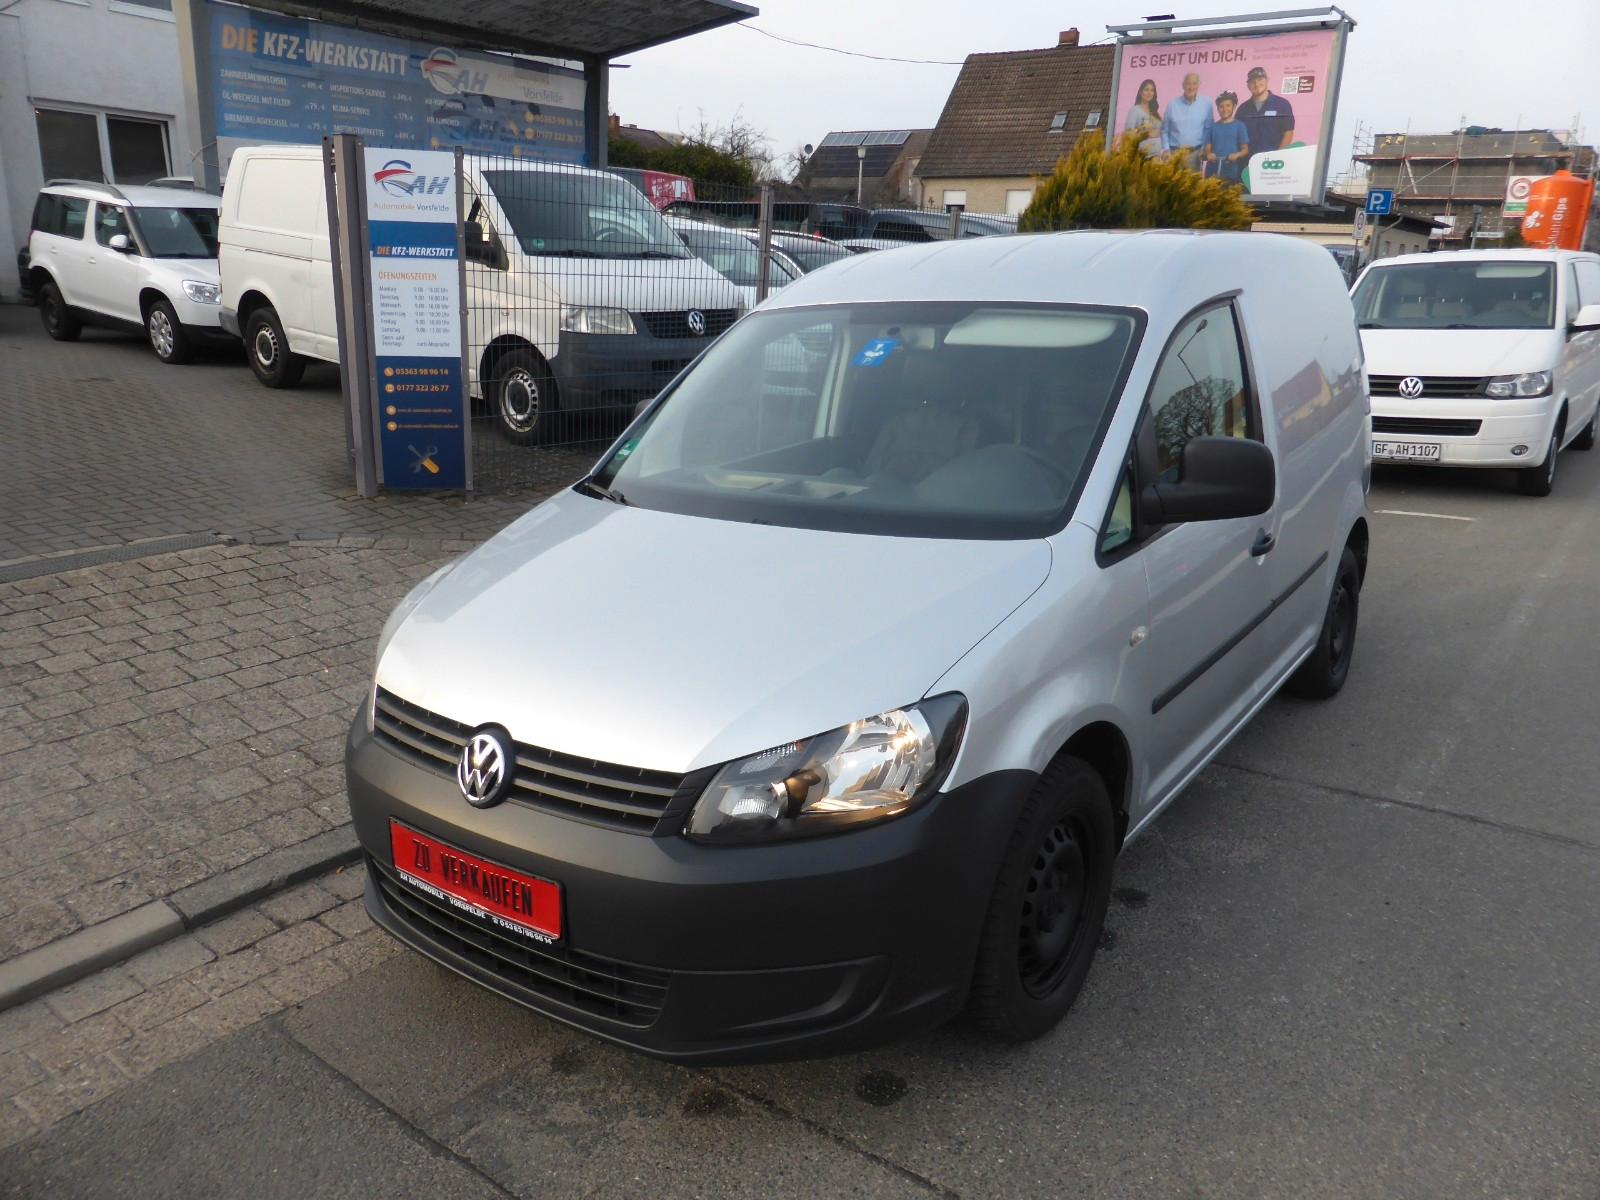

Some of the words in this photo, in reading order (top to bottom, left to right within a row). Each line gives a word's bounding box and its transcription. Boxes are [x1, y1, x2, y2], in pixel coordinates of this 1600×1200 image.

[222, 23, 257, 53] DIE
[263, 31, 408, 76] KFZ-WERKSTATT
[1130, 55, 1147, 69] ES
[1150, 52, 1185, 67] GEHT
[1188, 51, 1208, 65] UM
[1211, 48, 1247, 63] DICH.
[456, 69, 489, 93] AH
[411, 175, 450, 195] AH
[416, 203, 450, 212] Vorsfelde
[1369, 192, 1385, 211] P
[376, 245, 392, 256] DIE
[391, 246, 454, 257] KFZ-WERKSTATT
[396, 384, 414, 392] 0177
[1375, 443, 1388, 454] GF
[412, 838, 431, 873] ZU
[440, 851, 533, 918] VERKAUFEN
[449, 895, 487, 919] VORSFELDE
